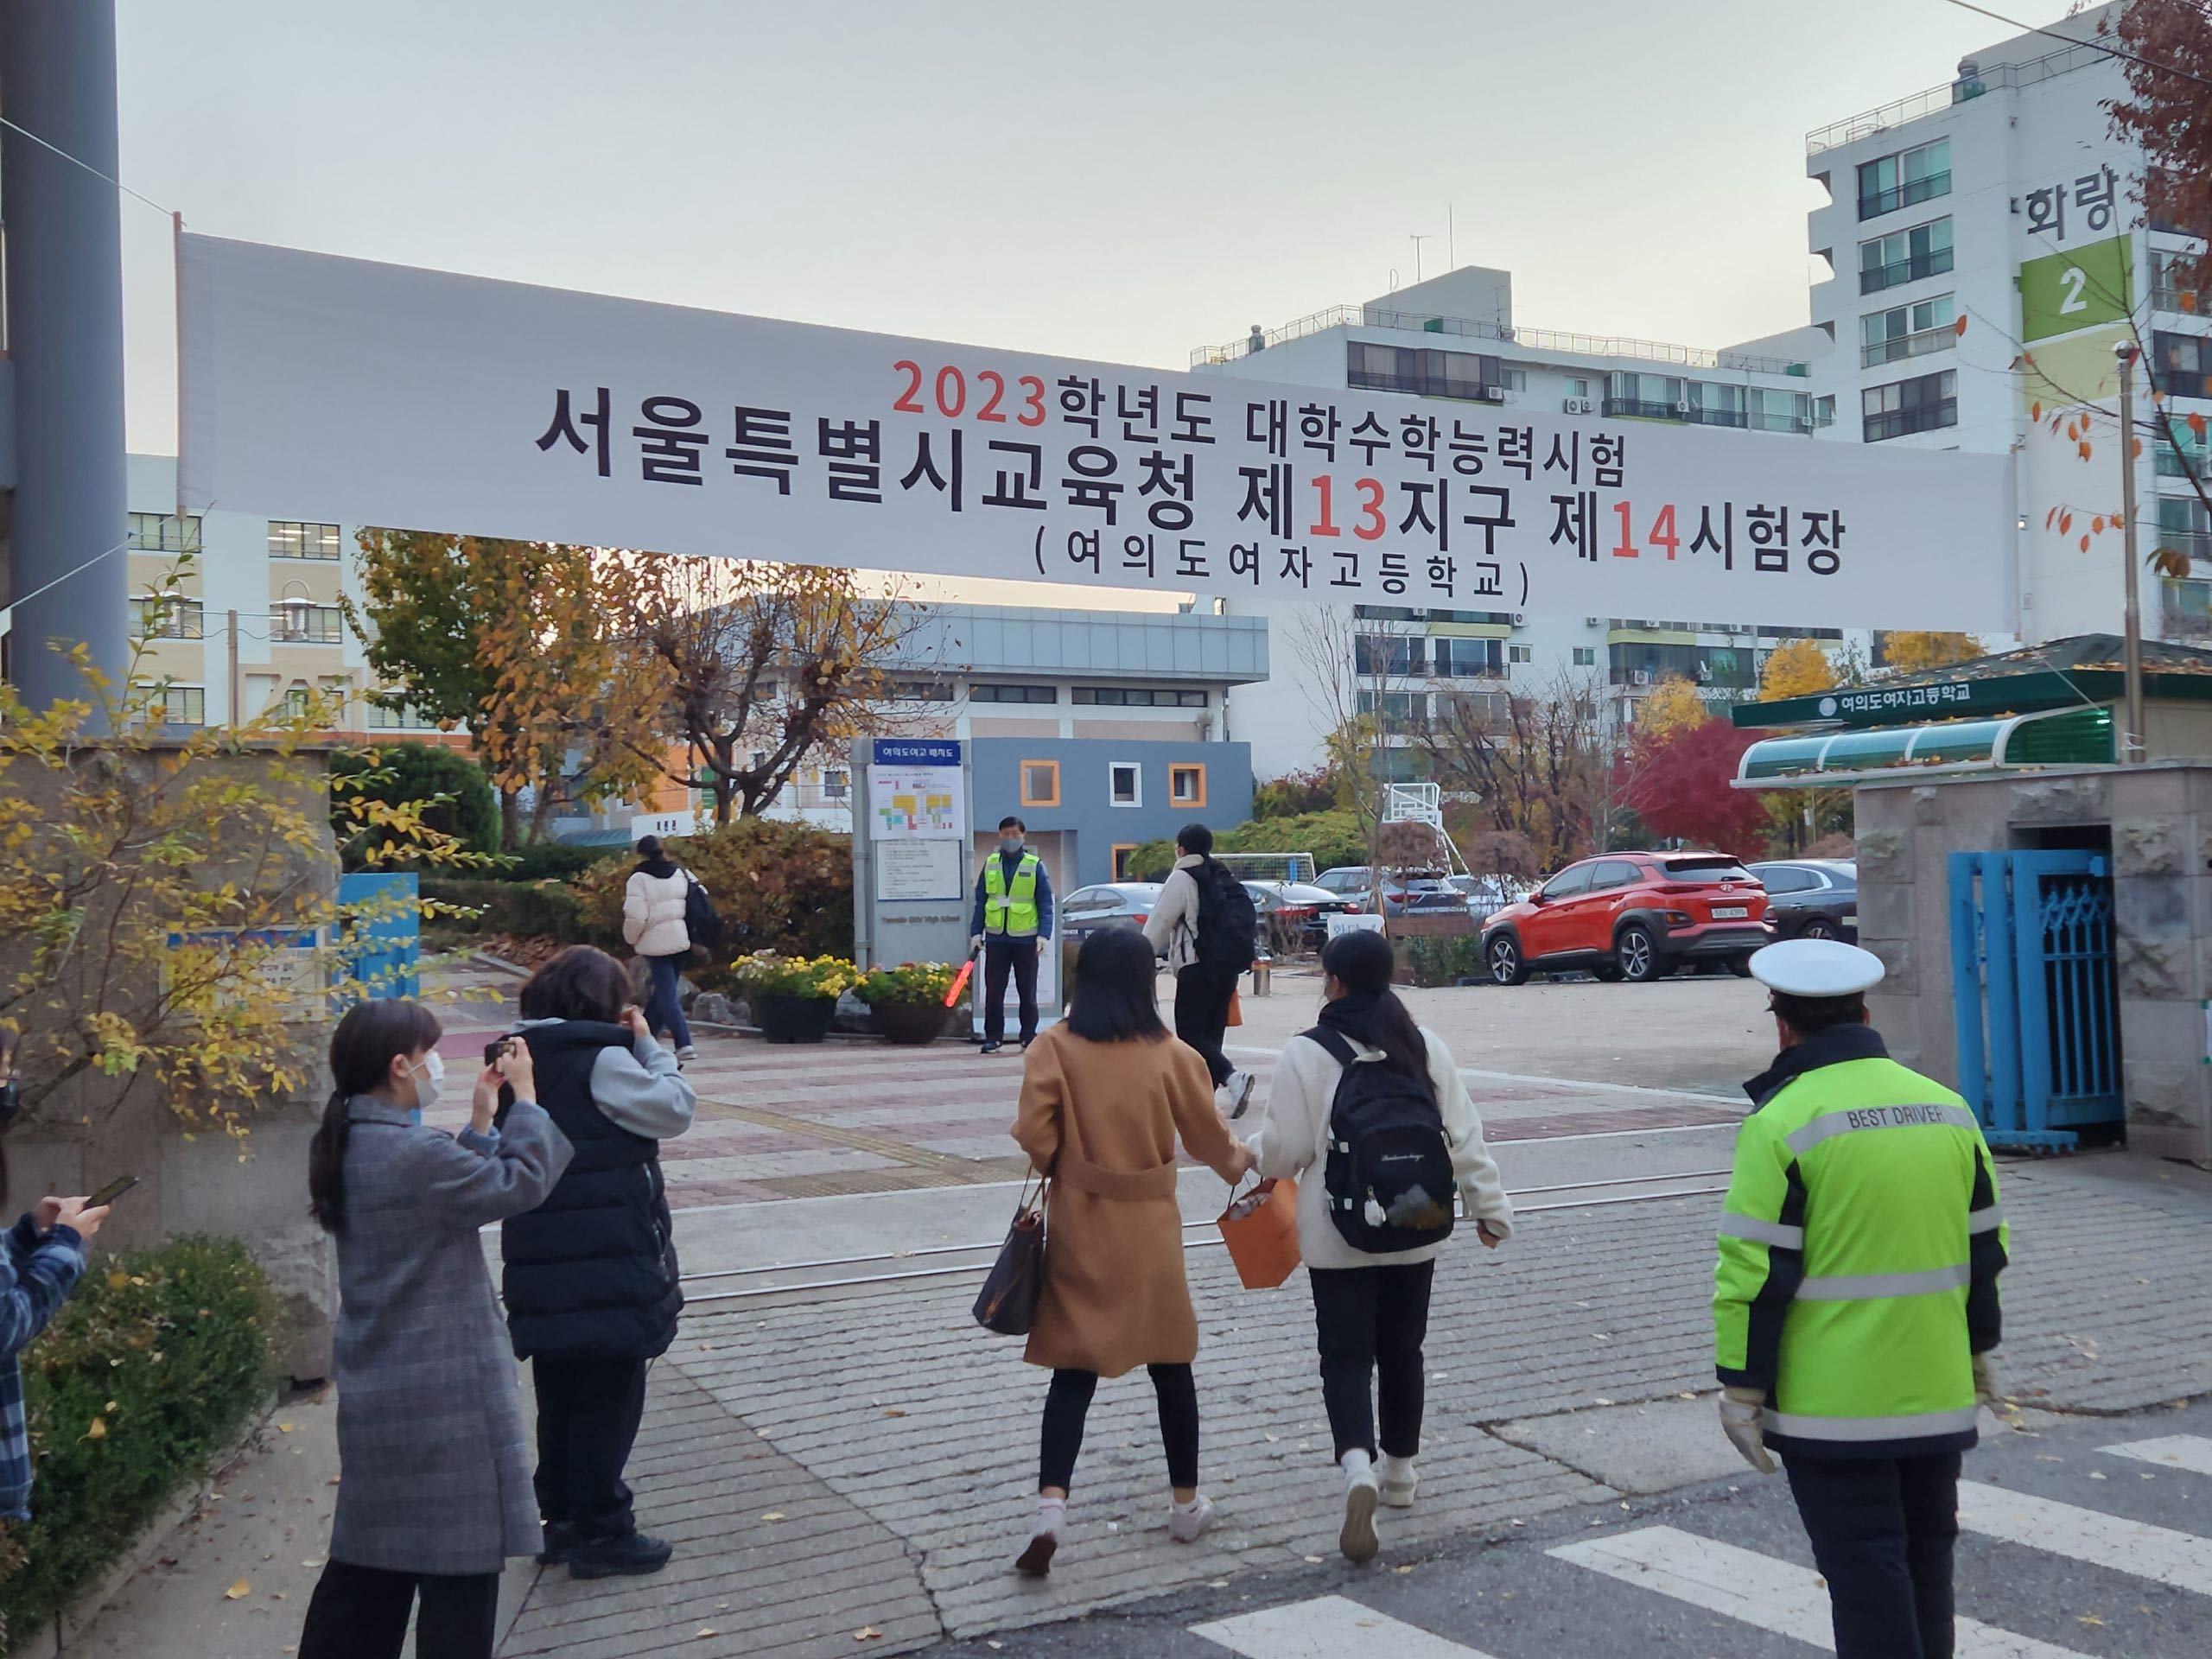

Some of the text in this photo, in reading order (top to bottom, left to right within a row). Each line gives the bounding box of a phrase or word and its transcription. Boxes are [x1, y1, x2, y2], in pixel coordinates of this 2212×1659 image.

[2025, 168, 2120, 241] 화랑
[2059, 266, 2088, 315] 2
[892, 359, 1626, 488] 2023학년도 대학수학능력시험
[535, 386, 1847, 576] 서울특별시교육청 제13지구 제14시험장
[1840, 683, 1972, 713] 여의도여자고등학교
[1847, 1105, 1943, 1129] BEST DRIVER
